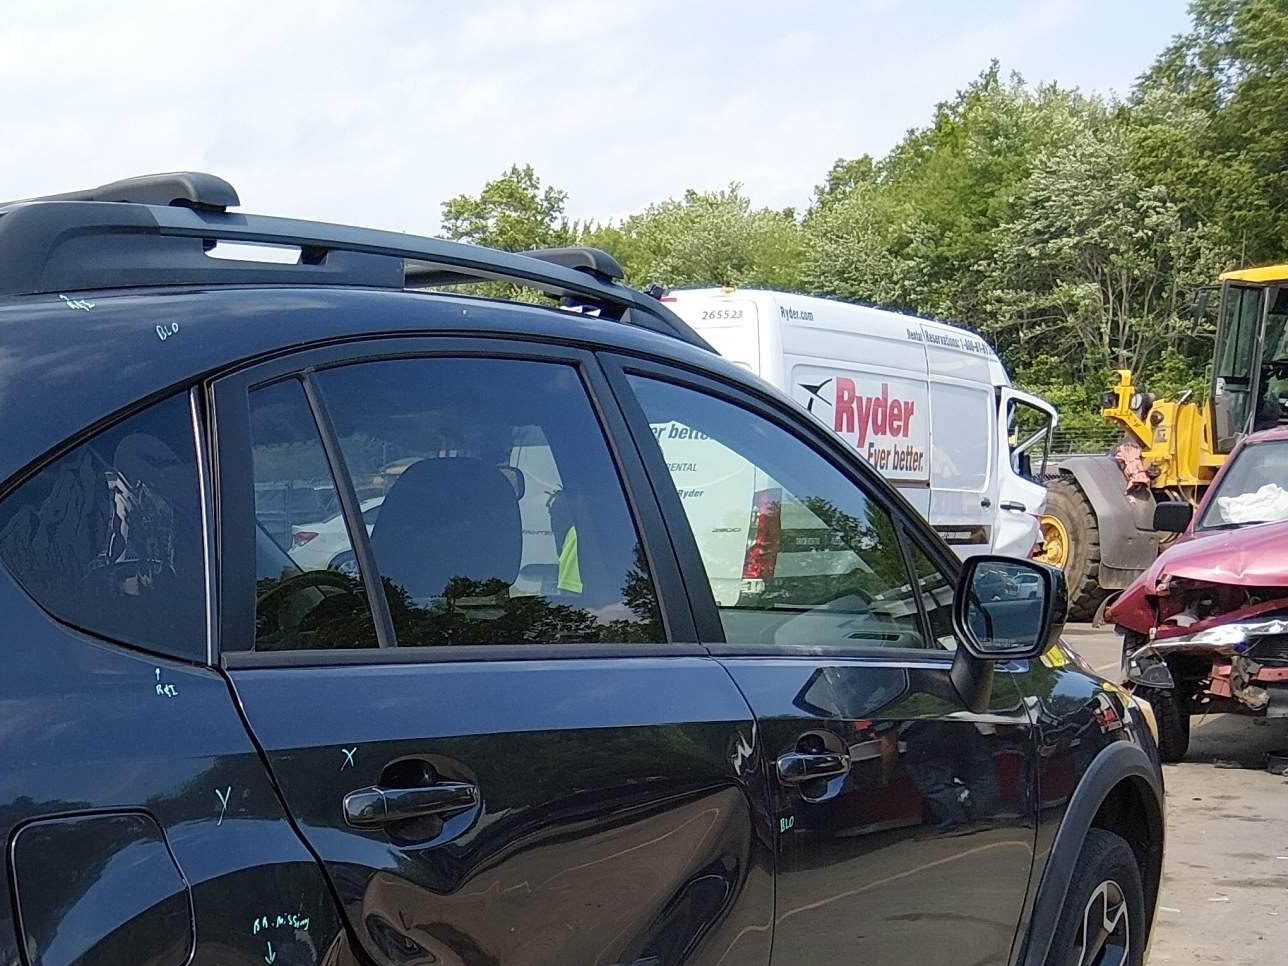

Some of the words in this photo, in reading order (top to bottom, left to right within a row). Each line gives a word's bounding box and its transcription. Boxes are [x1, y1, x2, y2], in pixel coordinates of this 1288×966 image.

[702, 309, 744, 321] 265523
[779, 305, 815, 322] Ryder.com
[834, 376, 915, 449] Ryder
[892, 443, 924, 473] better.
[678, 489, 704, 499] Ryder
